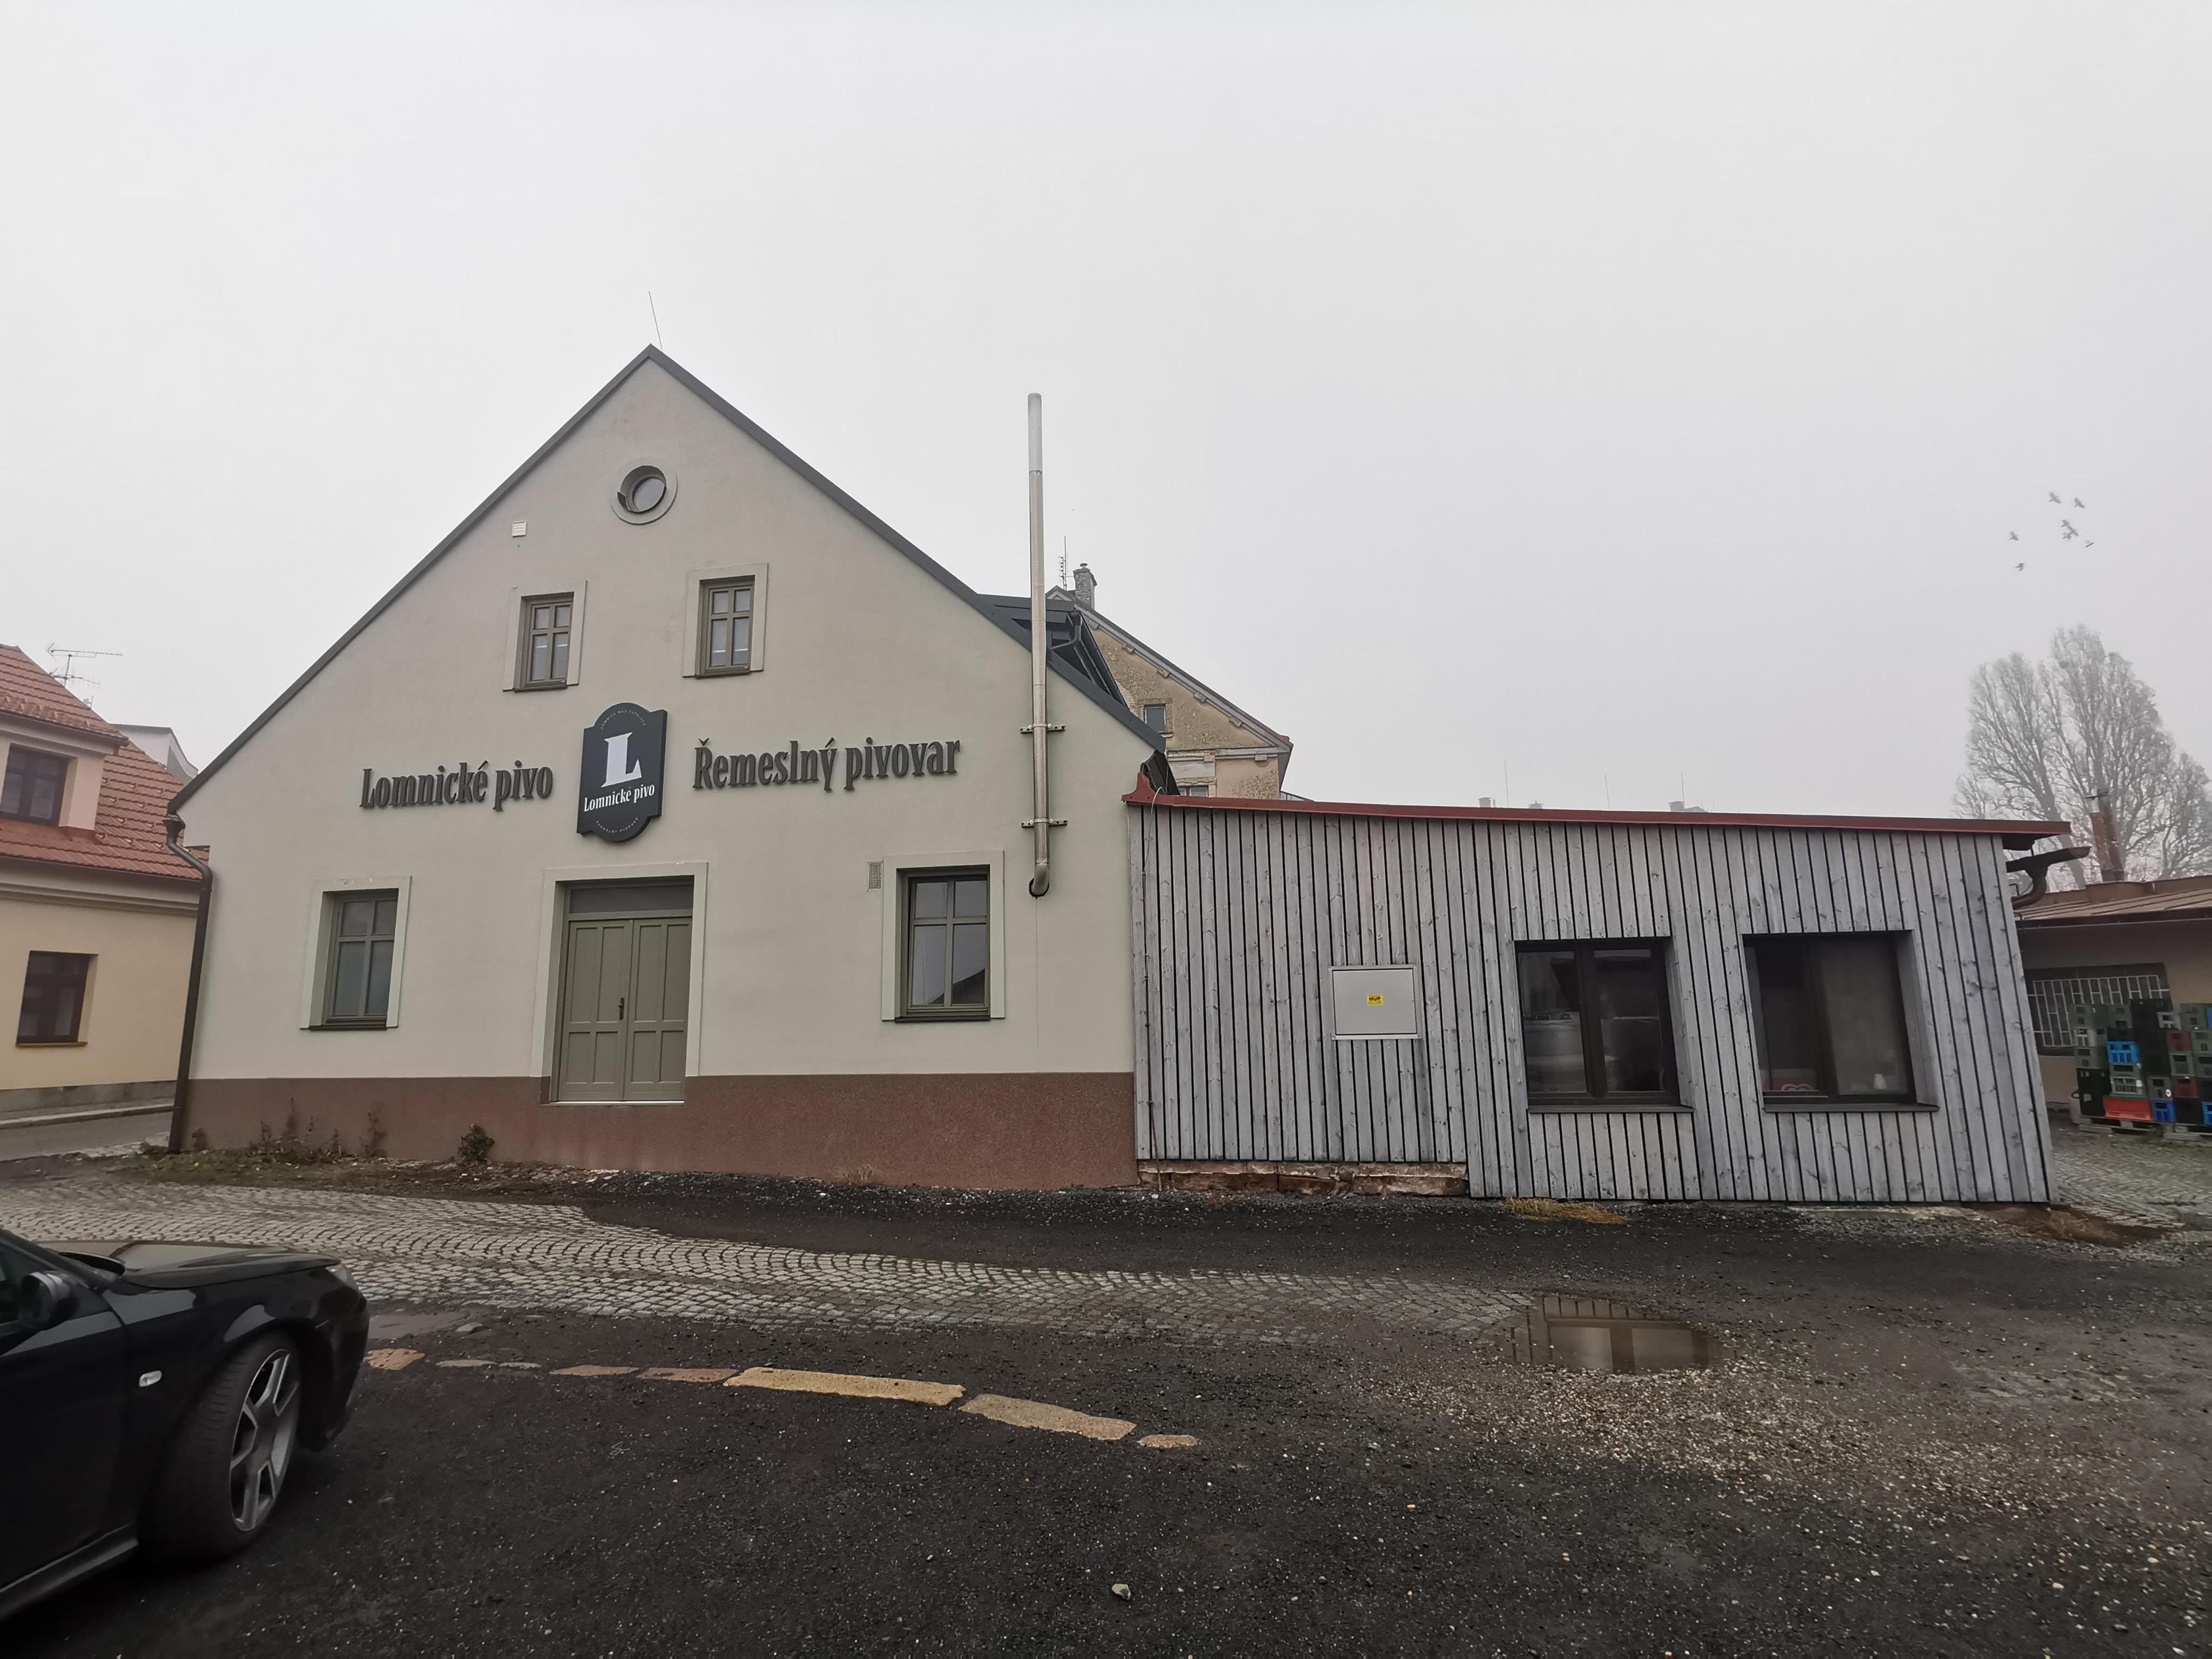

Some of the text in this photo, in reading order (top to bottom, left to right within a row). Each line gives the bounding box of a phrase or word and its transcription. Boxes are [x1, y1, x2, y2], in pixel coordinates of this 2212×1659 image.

[359, 760, 553, 811] Lomnické pivo
[601, 732, 642, 787] L
[692, 737, 960, 792] Řemeslný pivovar
[584, 784, 655, 812] Lomnické pivo
